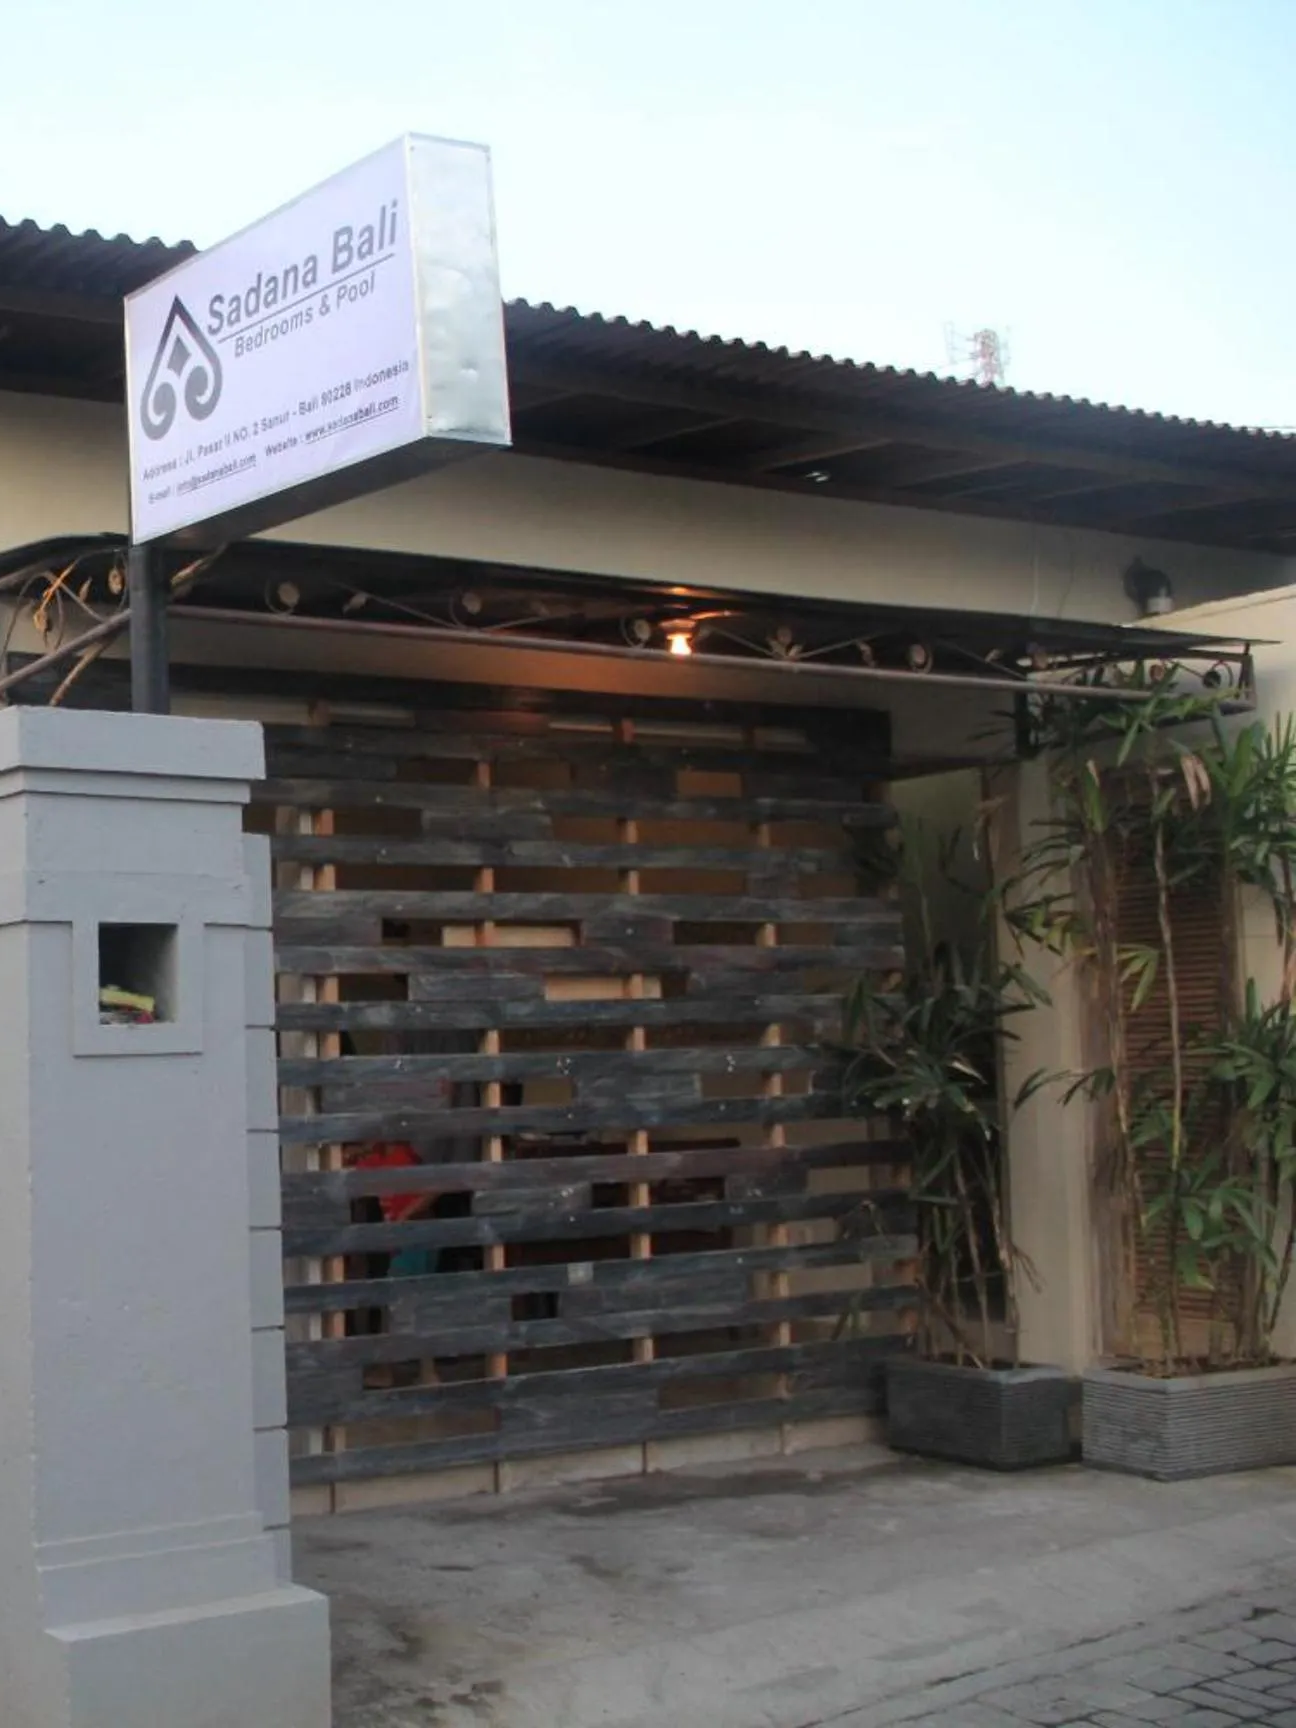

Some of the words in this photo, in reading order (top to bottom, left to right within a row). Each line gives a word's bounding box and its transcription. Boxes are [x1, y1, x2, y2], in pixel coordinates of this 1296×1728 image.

[207, 254, 318, 336] Sadana
[331, 198, 398, 275] Bali
[234, 305, 313, 358] Bedrooms
[319, 294, 331, 316] &
[336, 270, 375, 310] Pool
[261, 410, 290, 432] Sanur
[353, 359, 410, 393] Indonesia
